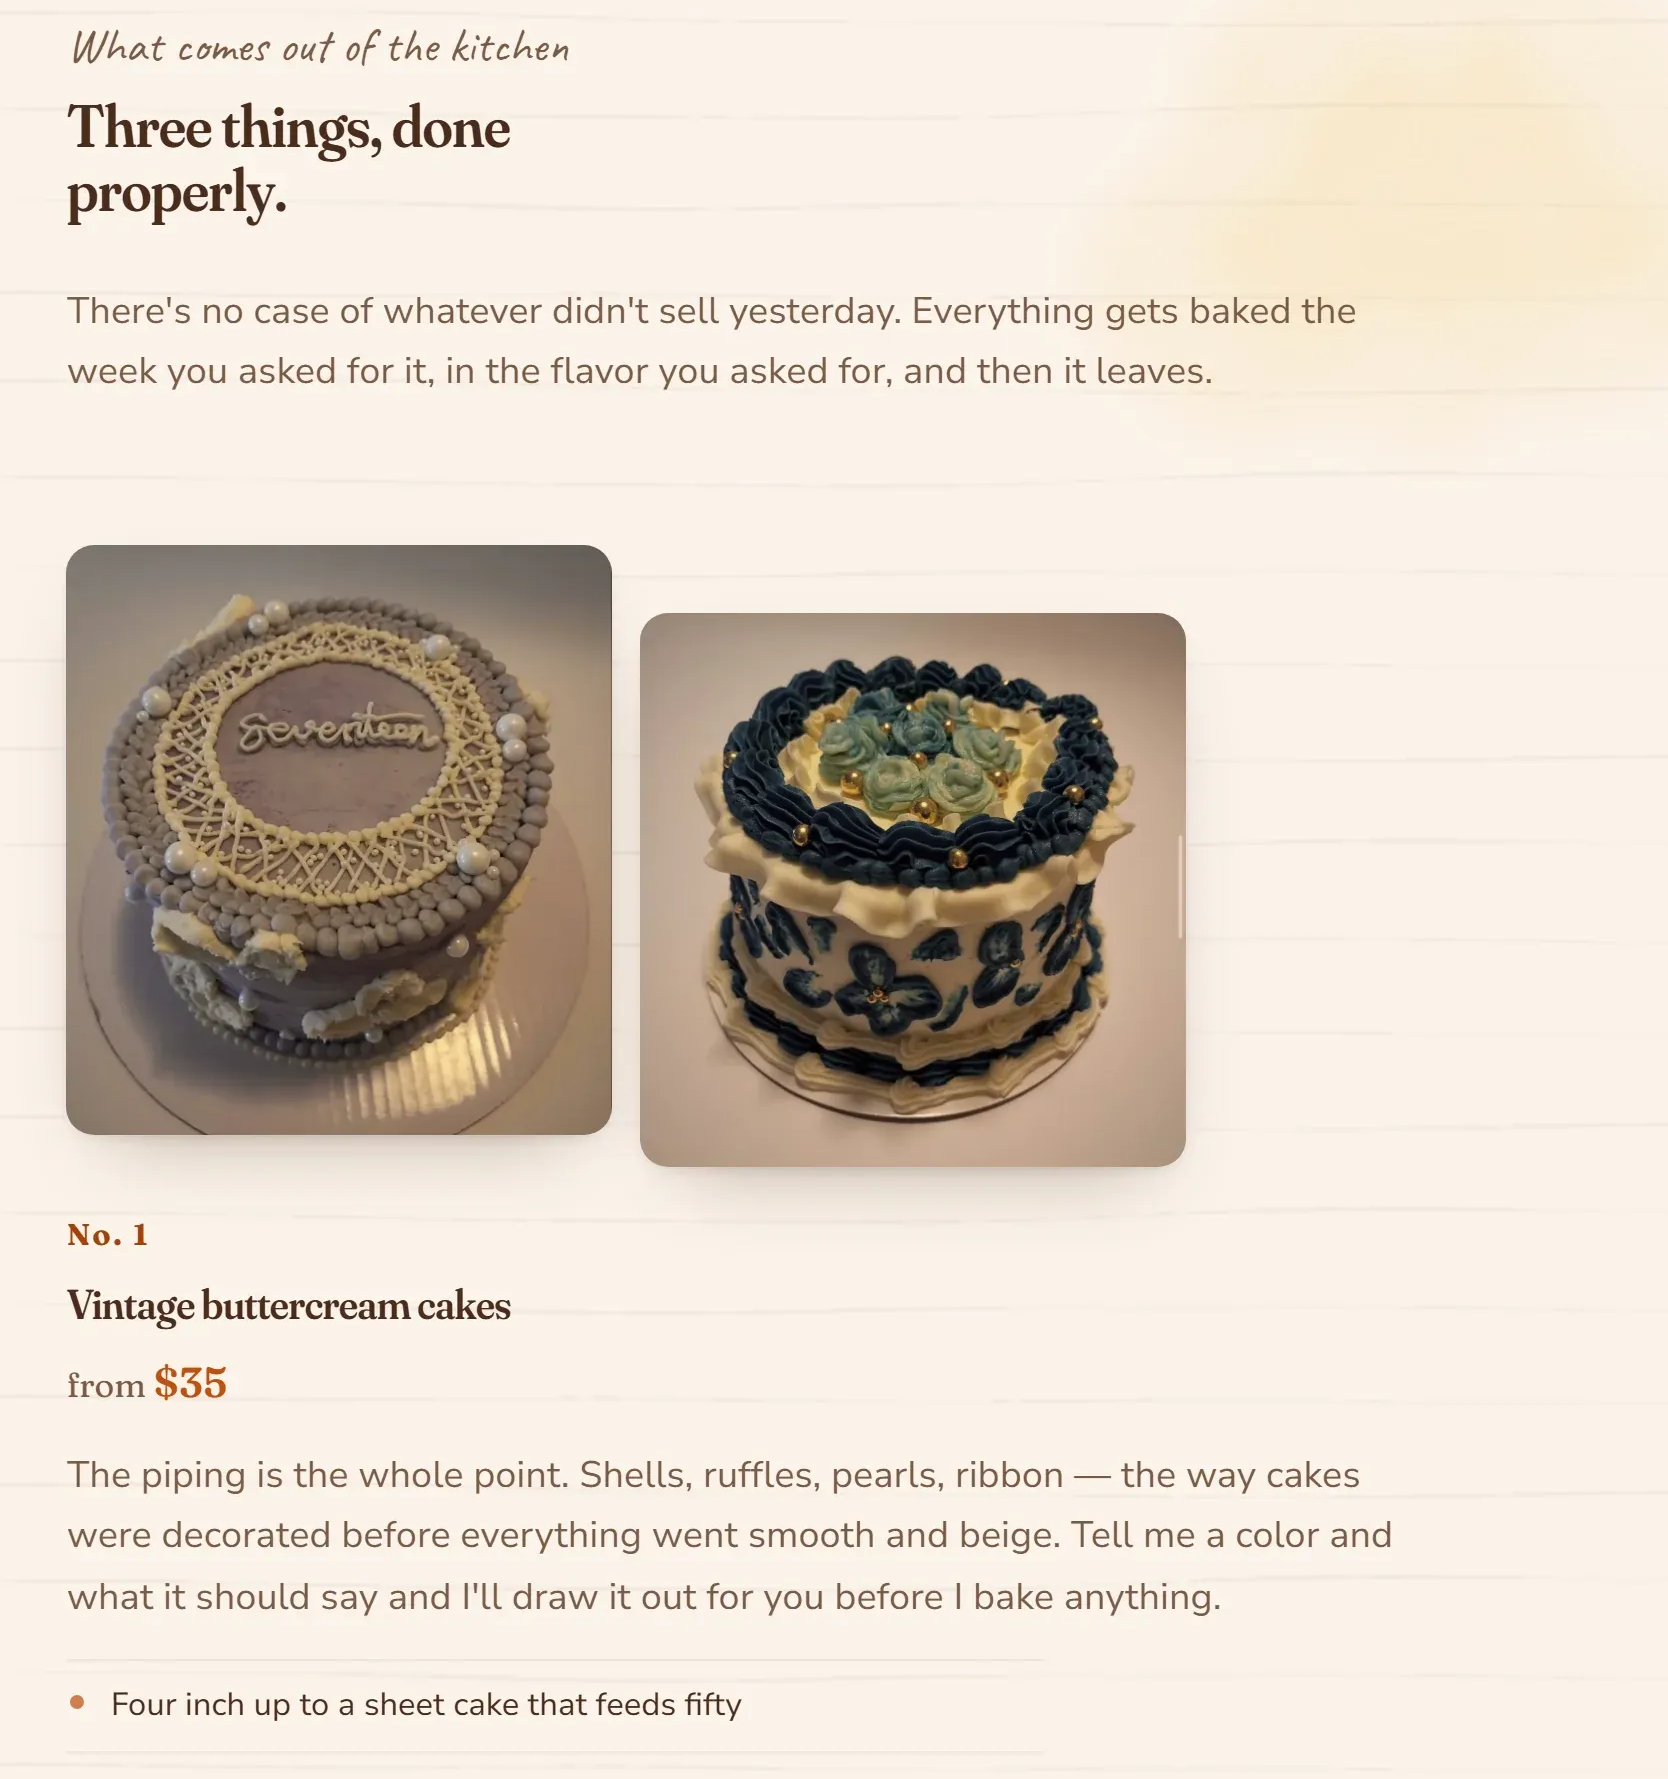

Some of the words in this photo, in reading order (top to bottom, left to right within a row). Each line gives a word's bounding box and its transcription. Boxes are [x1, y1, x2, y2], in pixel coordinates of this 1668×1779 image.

[72, 29, 167, 65] What
[178, 40, 272, 62] comes
[282, 31, 336, 64] out
[345, 28, 382, 67] of
[388, 29, 441, 62] the
[451, 28, 569, 62] kitchen
[67, 101, 212, 149] Three
[221, 101, 382, 163] things,
[392, 101, 511, 149] done
[66, 165, 287, 227] properly.
[66, 296, 191, 325] There's
[203, 303, 243, 324] no
[254, 303, 329, 324] case
[340, 296, 375, 324] of
[383, 296, 543, 325] whatever
[553, 296, 650, 324] didn't
[659, 296, 720, 325] sell
[728, 296, 901, 331] yesterday.
[914, 296, 1093, 331] Everything
[1105, 298, 1178, 331] gets
[1191, 296, 1290, 325] baked
[1300, 296, 1356, 325] the
[67, 1223, 122, 1247] No.
[133, 1222, 148, 1246] 1
[66, 1288, 196, 1330] Vintage
[200, 1287, 412, 1321] buttercream
[417, 1287, 512, 1321] cakes
[67, 1371, 146, 1398] from
[154, 1363, 227, 1402] $35
[66, 1460, 131, 1488] The
[143, 1460, 245, 1495] piping
[258, 1460, 283, 1489] is
[292, 1460, 348, 1489] the
[358, 1460, 463, 1489] whole
[475, 1460, 568, 1495] point.
[580, 1459, 692, 1492] Shells,
[705, 1460, 820, 1492] ruffles,
[833, 1460, 944, 1495] pearls,
[957, 1460, 1063, 1489] ribbon
[1120, 1460, 1176, 1489] the
[1186, 1467, 1257, 1495] way
[1267, 1460, 1360, 1489] cakes
[67, 1582, 155, 1610] what
[164, 1582, 187, 1610] it
[196, 1582, 309, 1611] should
[321, 1589, 379, 1617] say
[389, 1582, 450, 1610] and
[463, 1582, 503, 1610] I'll
[512, 1582, 599, 1611] draw
[610, 1582, 632, 1610] it
[641, 1584, 698, 1611] out
[706, 1582, 754, 1610] for
[763, 1589, 823, 1617] you
[836, 1582, 943, 1611] before
[956, 1582, 961, 1610] I
[975, 1582, 1054, 1611] bake
[1065, 1582, 1220, 1617] anything.
[112, 1691, 177, 1716] Four
[186, 1691, 244, 1716] inch
[255, 1698, 291, 1722] up
[299, 1693, 329, 1716] to
[338, 1698, 354, 1716] a
[365, 1691, 446, 1716] sheet
[454, 1691, 519, 1716] cake
[527, 1691, 588, 1716] that
[595, 1691, 676, 1716] feeds
[684, 1691, 743, 1722] fifty
